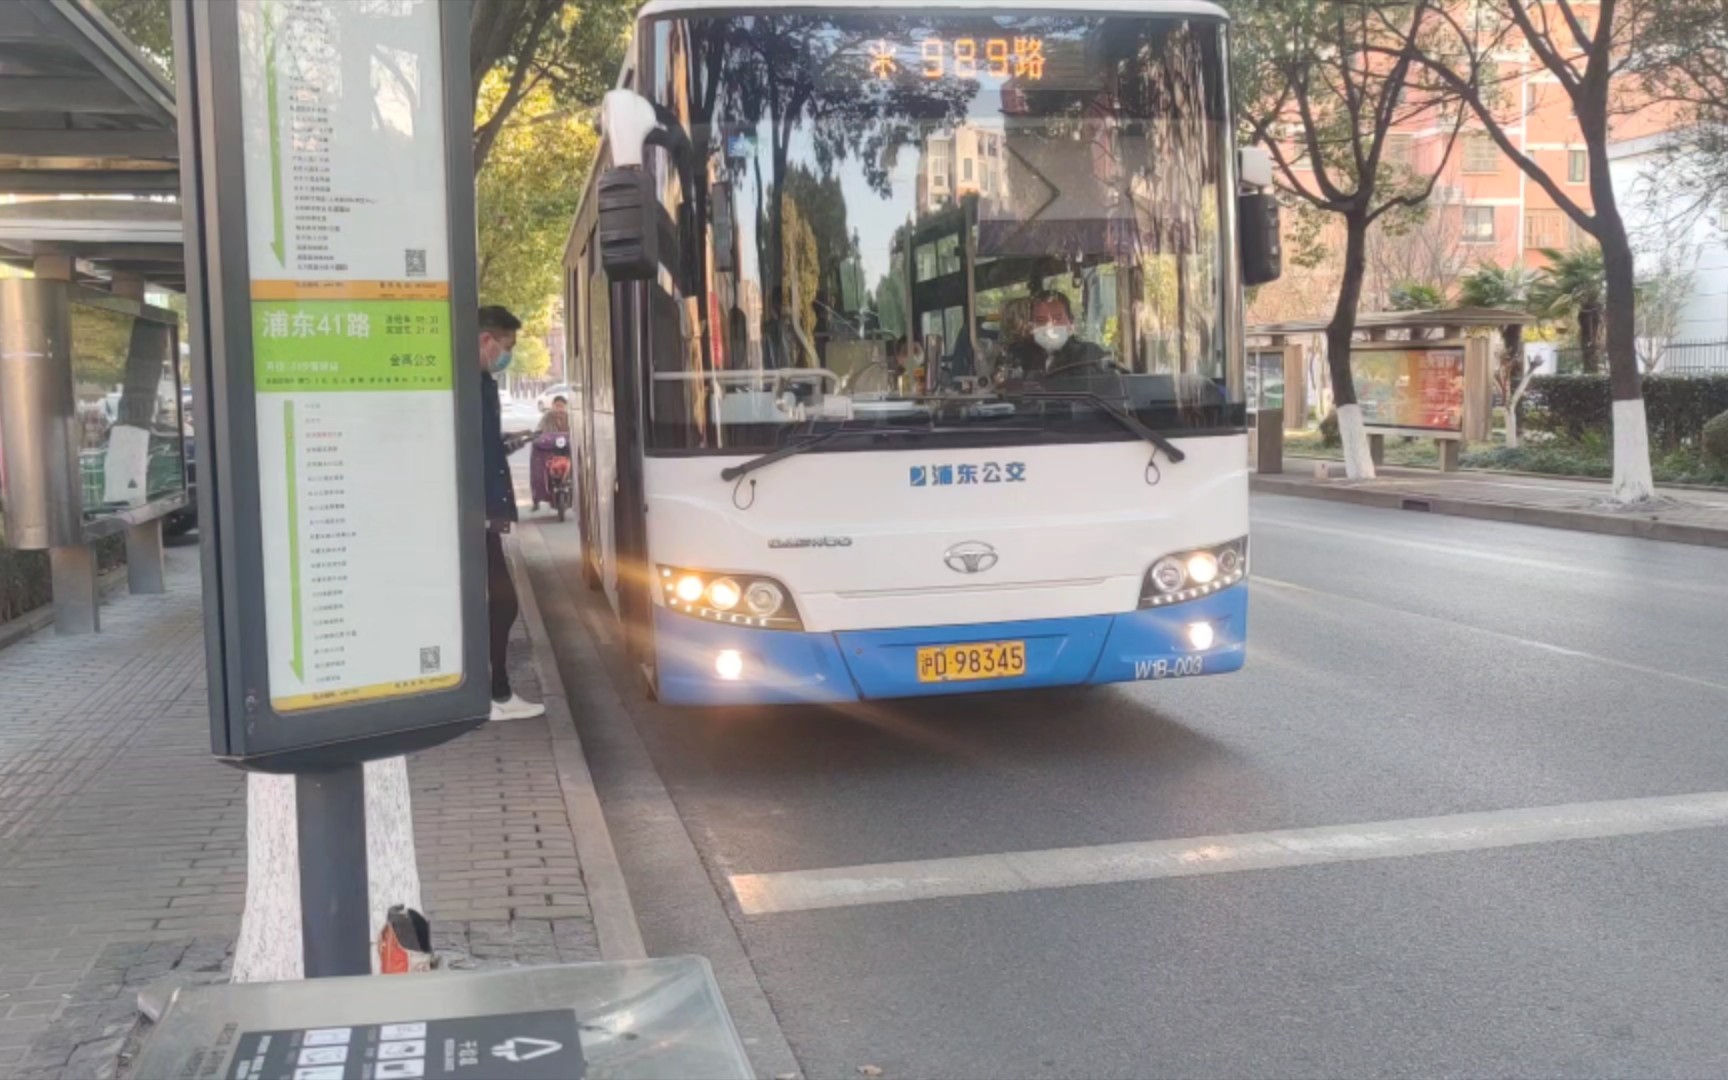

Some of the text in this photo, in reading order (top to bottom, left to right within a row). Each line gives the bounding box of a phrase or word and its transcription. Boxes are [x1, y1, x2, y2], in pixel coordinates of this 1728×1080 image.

[262, 309, 371, 341] 浦东41路
[931, 461, 1027, 486] 浦东公交
